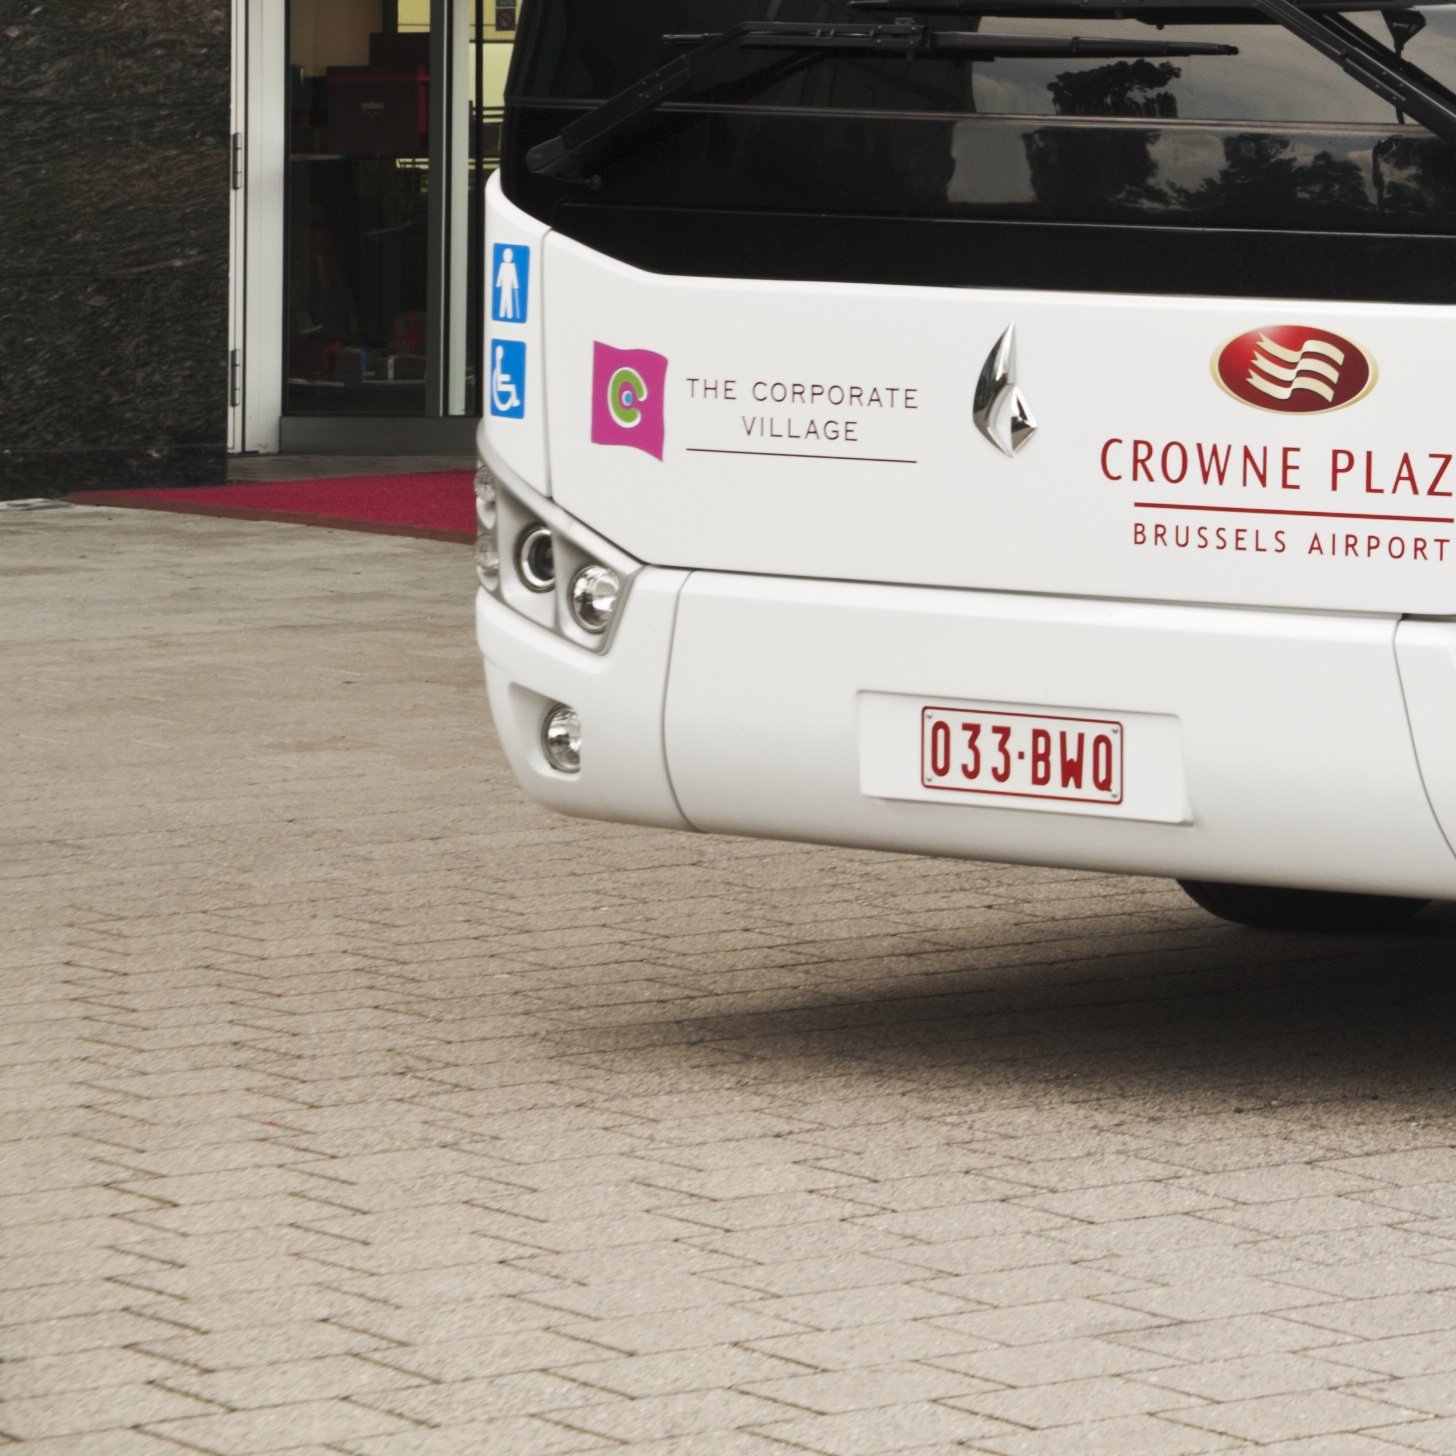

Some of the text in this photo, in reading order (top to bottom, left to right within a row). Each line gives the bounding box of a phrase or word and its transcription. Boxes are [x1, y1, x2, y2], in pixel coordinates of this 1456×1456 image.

[686, 377, 919, 409] THE CORPORATE
[741, 415, 859, 442] VILLAGE
[1100, 437, 1301, 490] CROWNE
[1133, 522, 1451, 562] BRUSSELS AIRPORT
